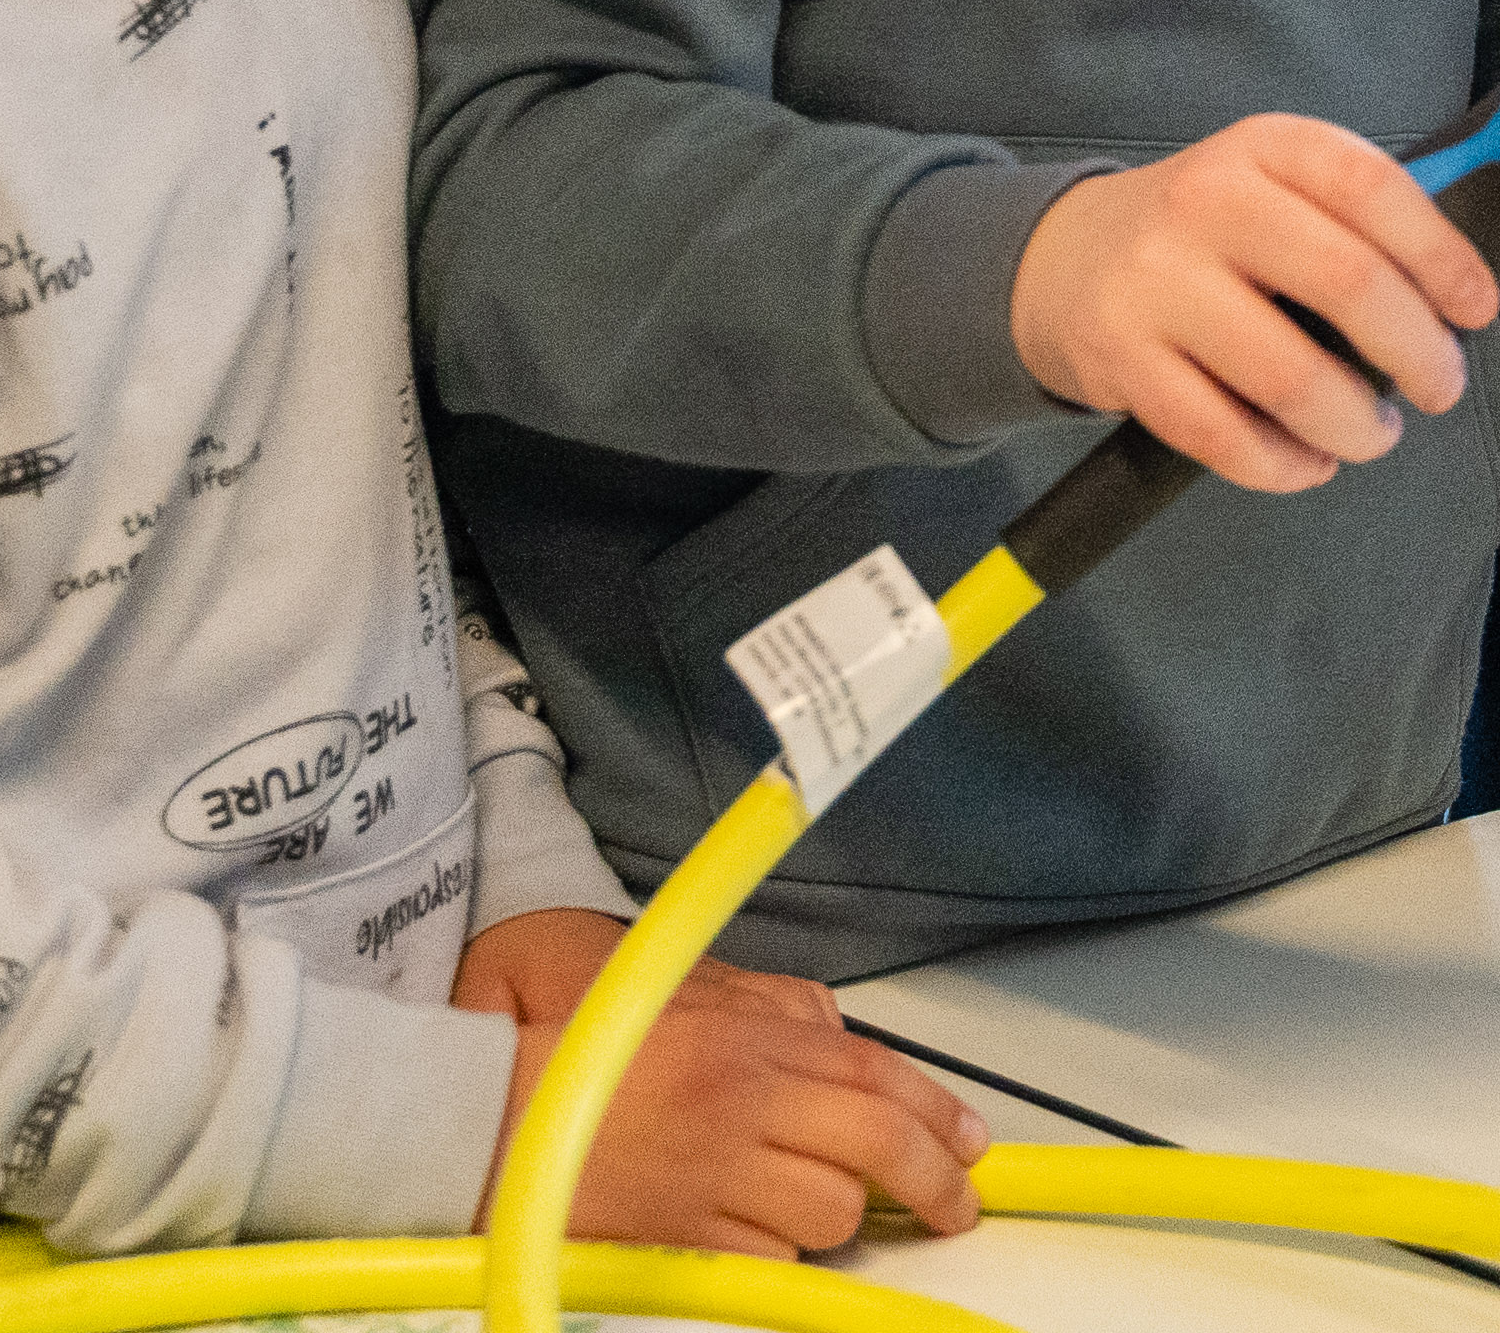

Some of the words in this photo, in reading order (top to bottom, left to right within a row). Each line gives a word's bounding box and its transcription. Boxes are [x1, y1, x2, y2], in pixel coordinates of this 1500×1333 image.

[364, 691, 419, 757] THE
[200, 731, 350, 832] FUTURE
[353, 776, 397, 836] WE
[255, 813, 332, 867] ARE
